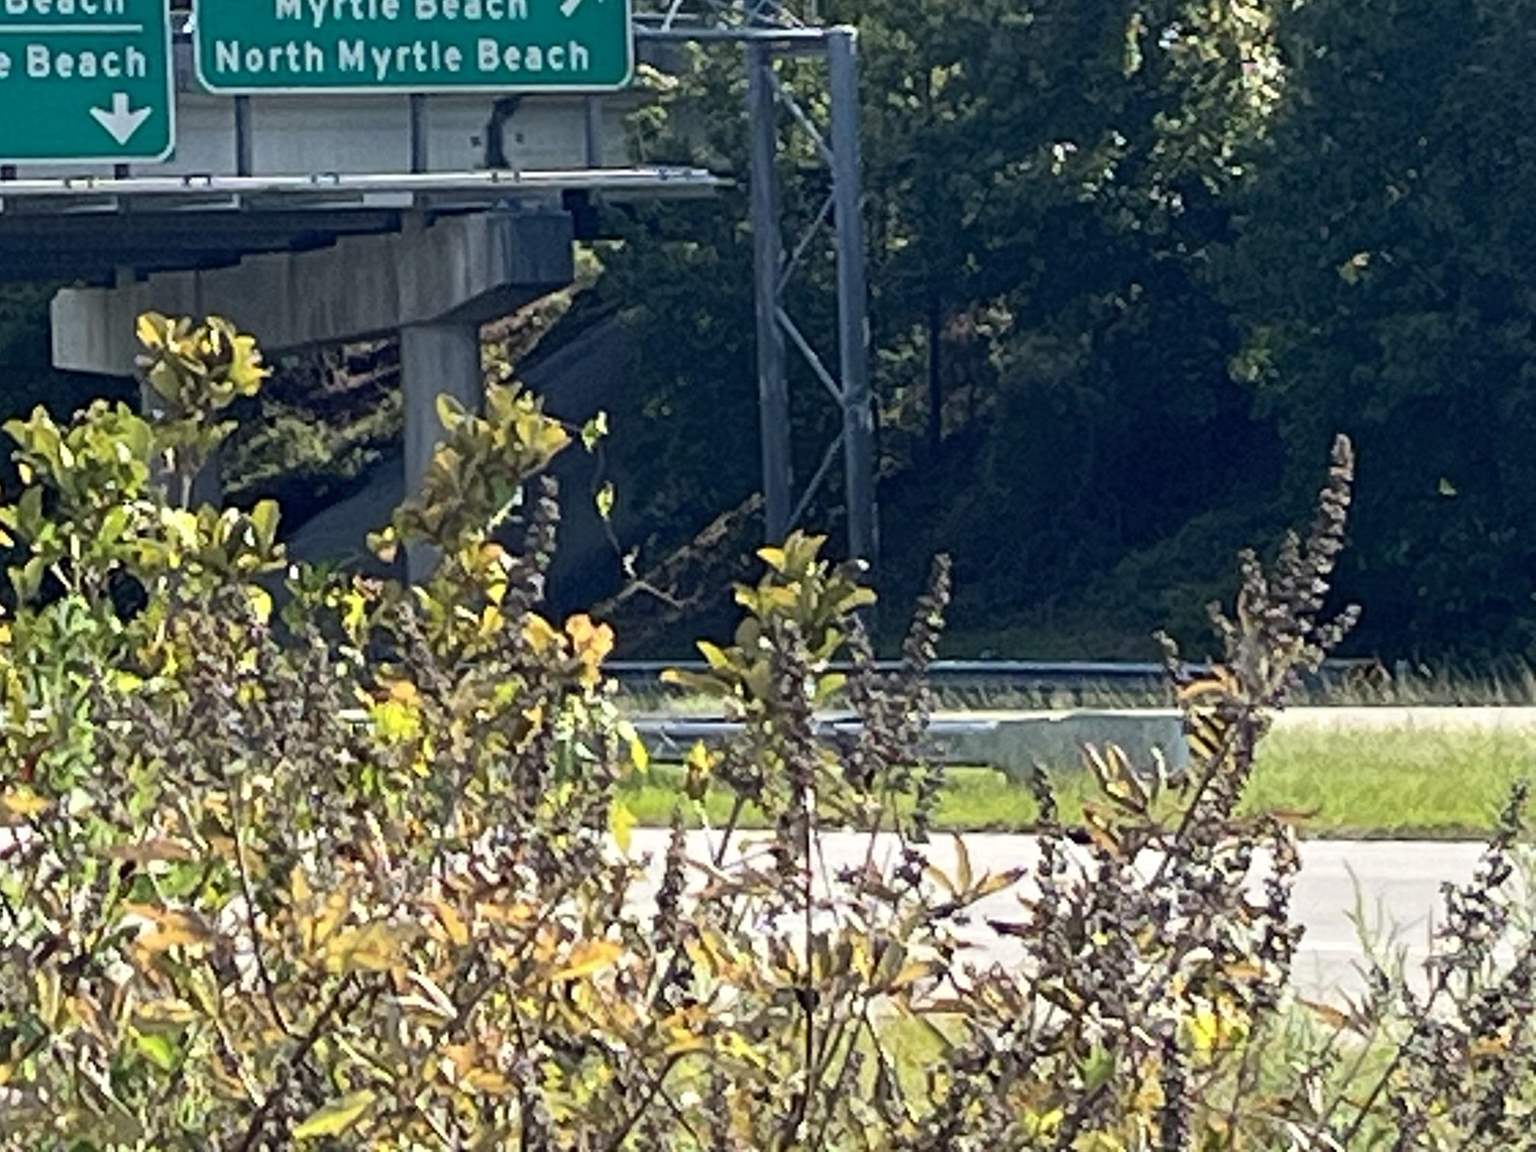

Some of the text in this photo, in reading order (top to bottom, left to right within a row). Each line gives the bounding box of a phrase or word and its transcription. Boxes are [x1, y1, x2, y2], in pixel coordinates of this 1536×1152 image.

[25, 44, 147, 79] Beach
[215, 37, 589, 81] North Myrtle Beach
